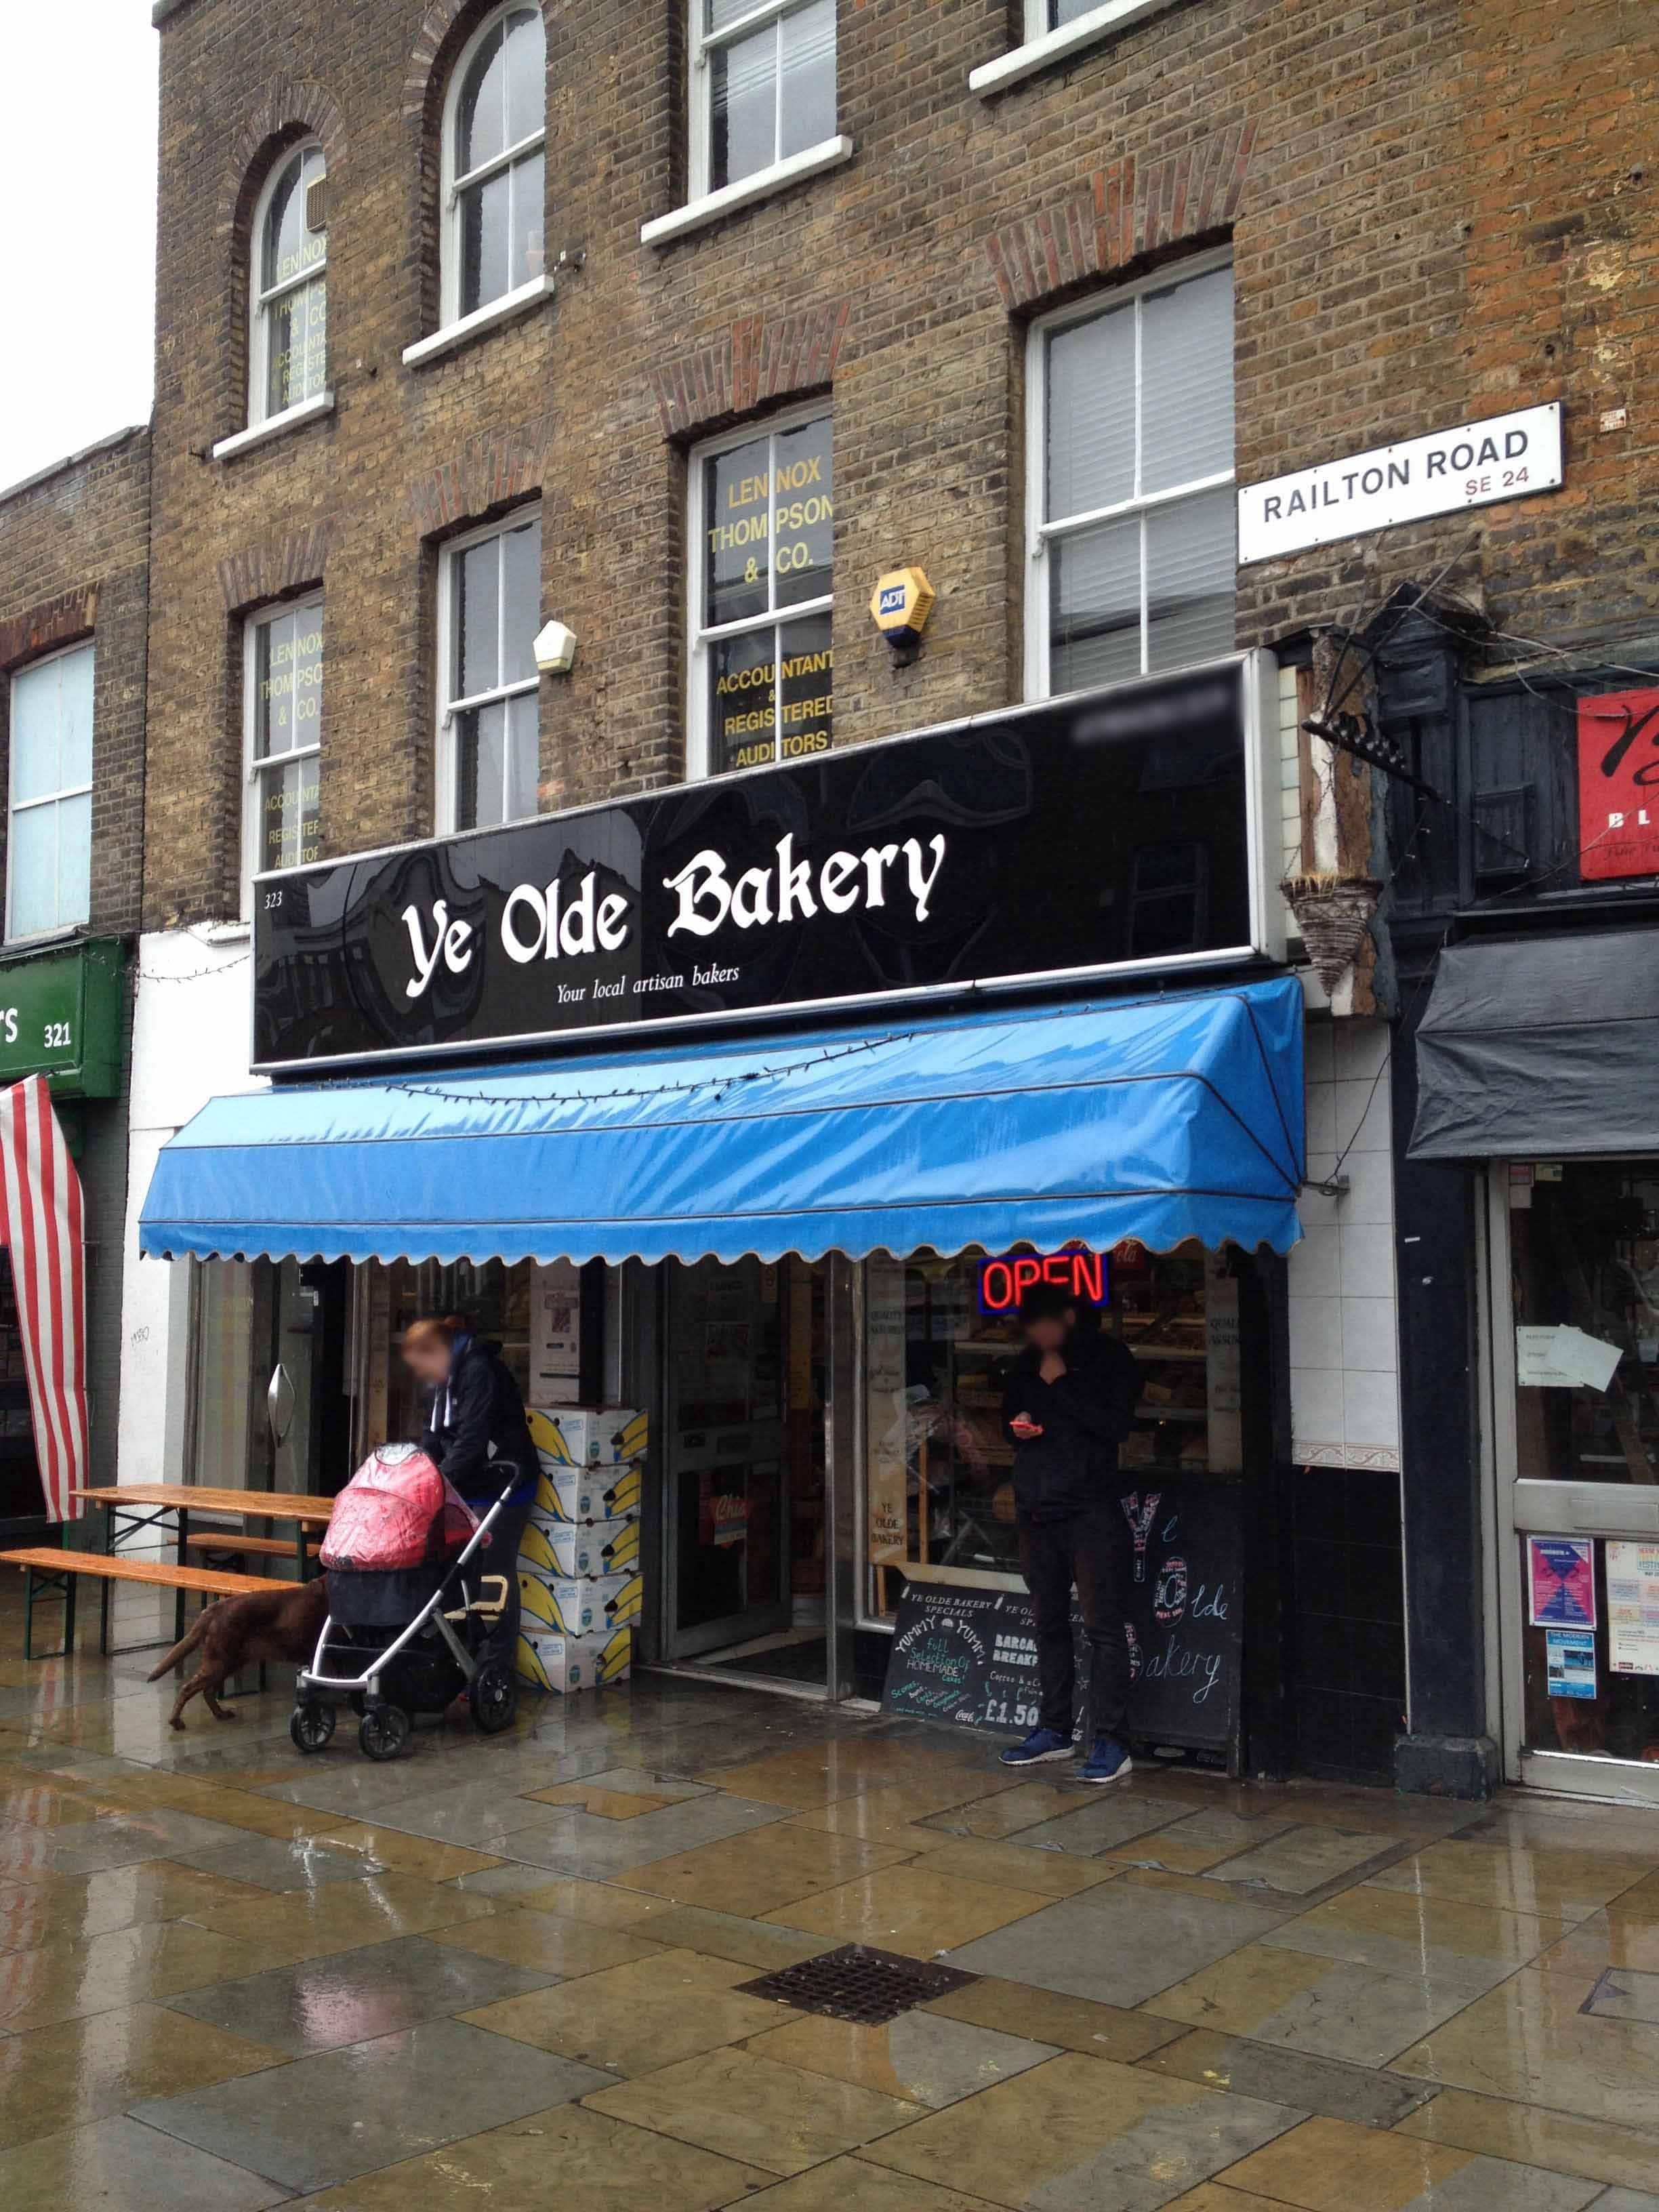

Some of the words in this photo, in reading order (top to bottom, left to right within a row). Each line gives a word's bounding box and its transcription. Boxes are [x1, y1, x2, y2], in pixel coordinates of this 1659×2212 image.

[729, 455, 822, 508] LENNOX
[1265, 459, 1409, 522] RAILTON
[1428, 430, 1528, 478] ROAD
[1465, 476, 1491, 495] SE
[1502, 466, 1529, 487] 24
[708, 494, 835, 554] THOMPSON
[745, 556, 759, 583] &
[776, 542, 813, 573] CO.
[881, 590, 904, 610] ADT
[279, 705, 287, 726] &
[736, 730, 828, 768] AUDITORS
[264, 890, 283, 909] 323
[401, 900, 472, 998] Ye
[501, 872, 628, 964] Olde
[663, 833, 945, 937] Bakery
[556, 984, 586, 1004] Your
[592, 975, 626, 999] local
[633, 974, 684, 993] artisan
[692, 962, 740, 986] bakers
[44, 1022, 70, 1048] 321
[983, 1252, 1103, 1309] OPEN
[875, 1518, 900, 1530] OLDE
[924, 1605, 974, 1618] SPECIALS
[925, 1595, 951, 1605] OLDE
[954, 1597, 993, 1609] BAKERY
[895, 1615, 936, 1653] YUMMY
[907, 1658, 959, 1677] HOMEMADE
[985, 1699, 1039, 1727] £1.50
